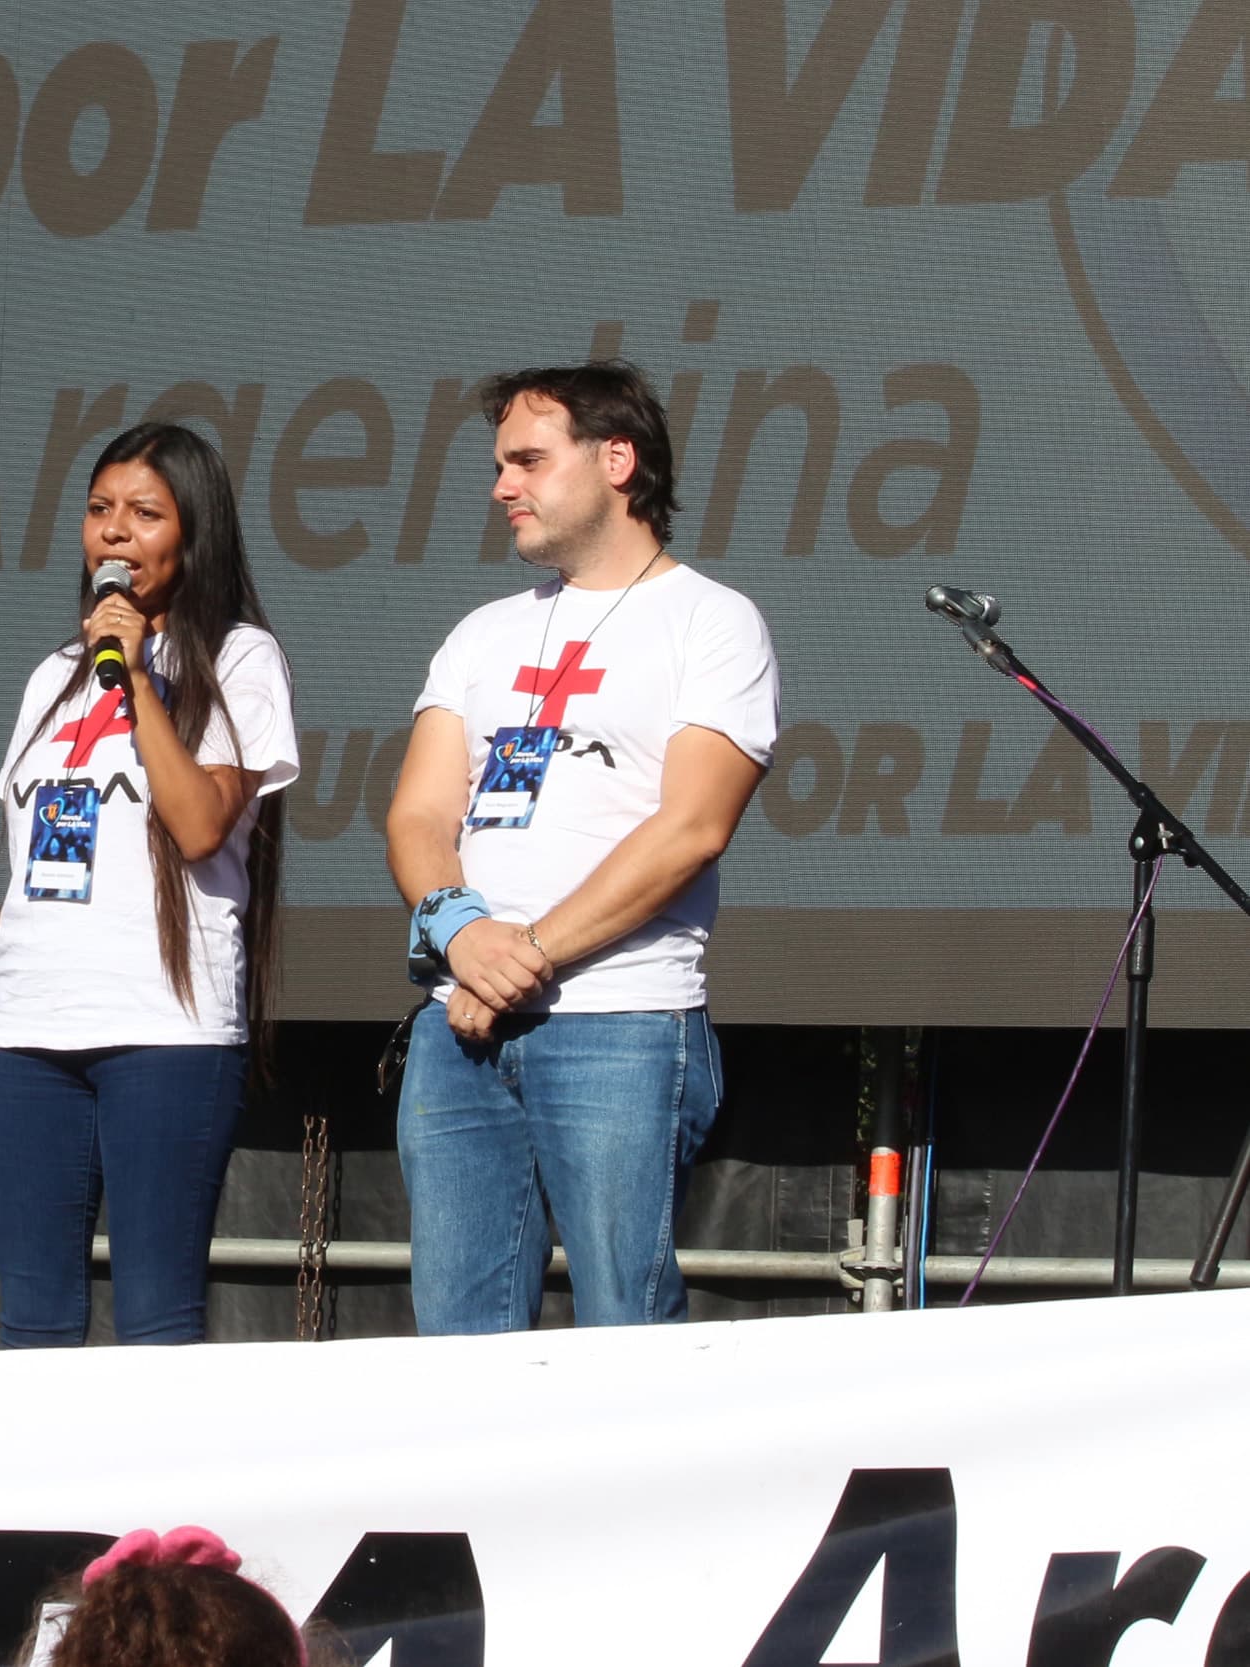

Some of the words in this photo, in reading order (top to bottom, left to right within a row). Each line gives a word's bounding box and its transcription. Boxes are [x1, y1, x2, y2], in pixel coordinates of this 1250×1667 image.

[302, 0, 624, 226] LA
[757, 721, 926, 839] OR
[940, 721, 1093, 834] LA
